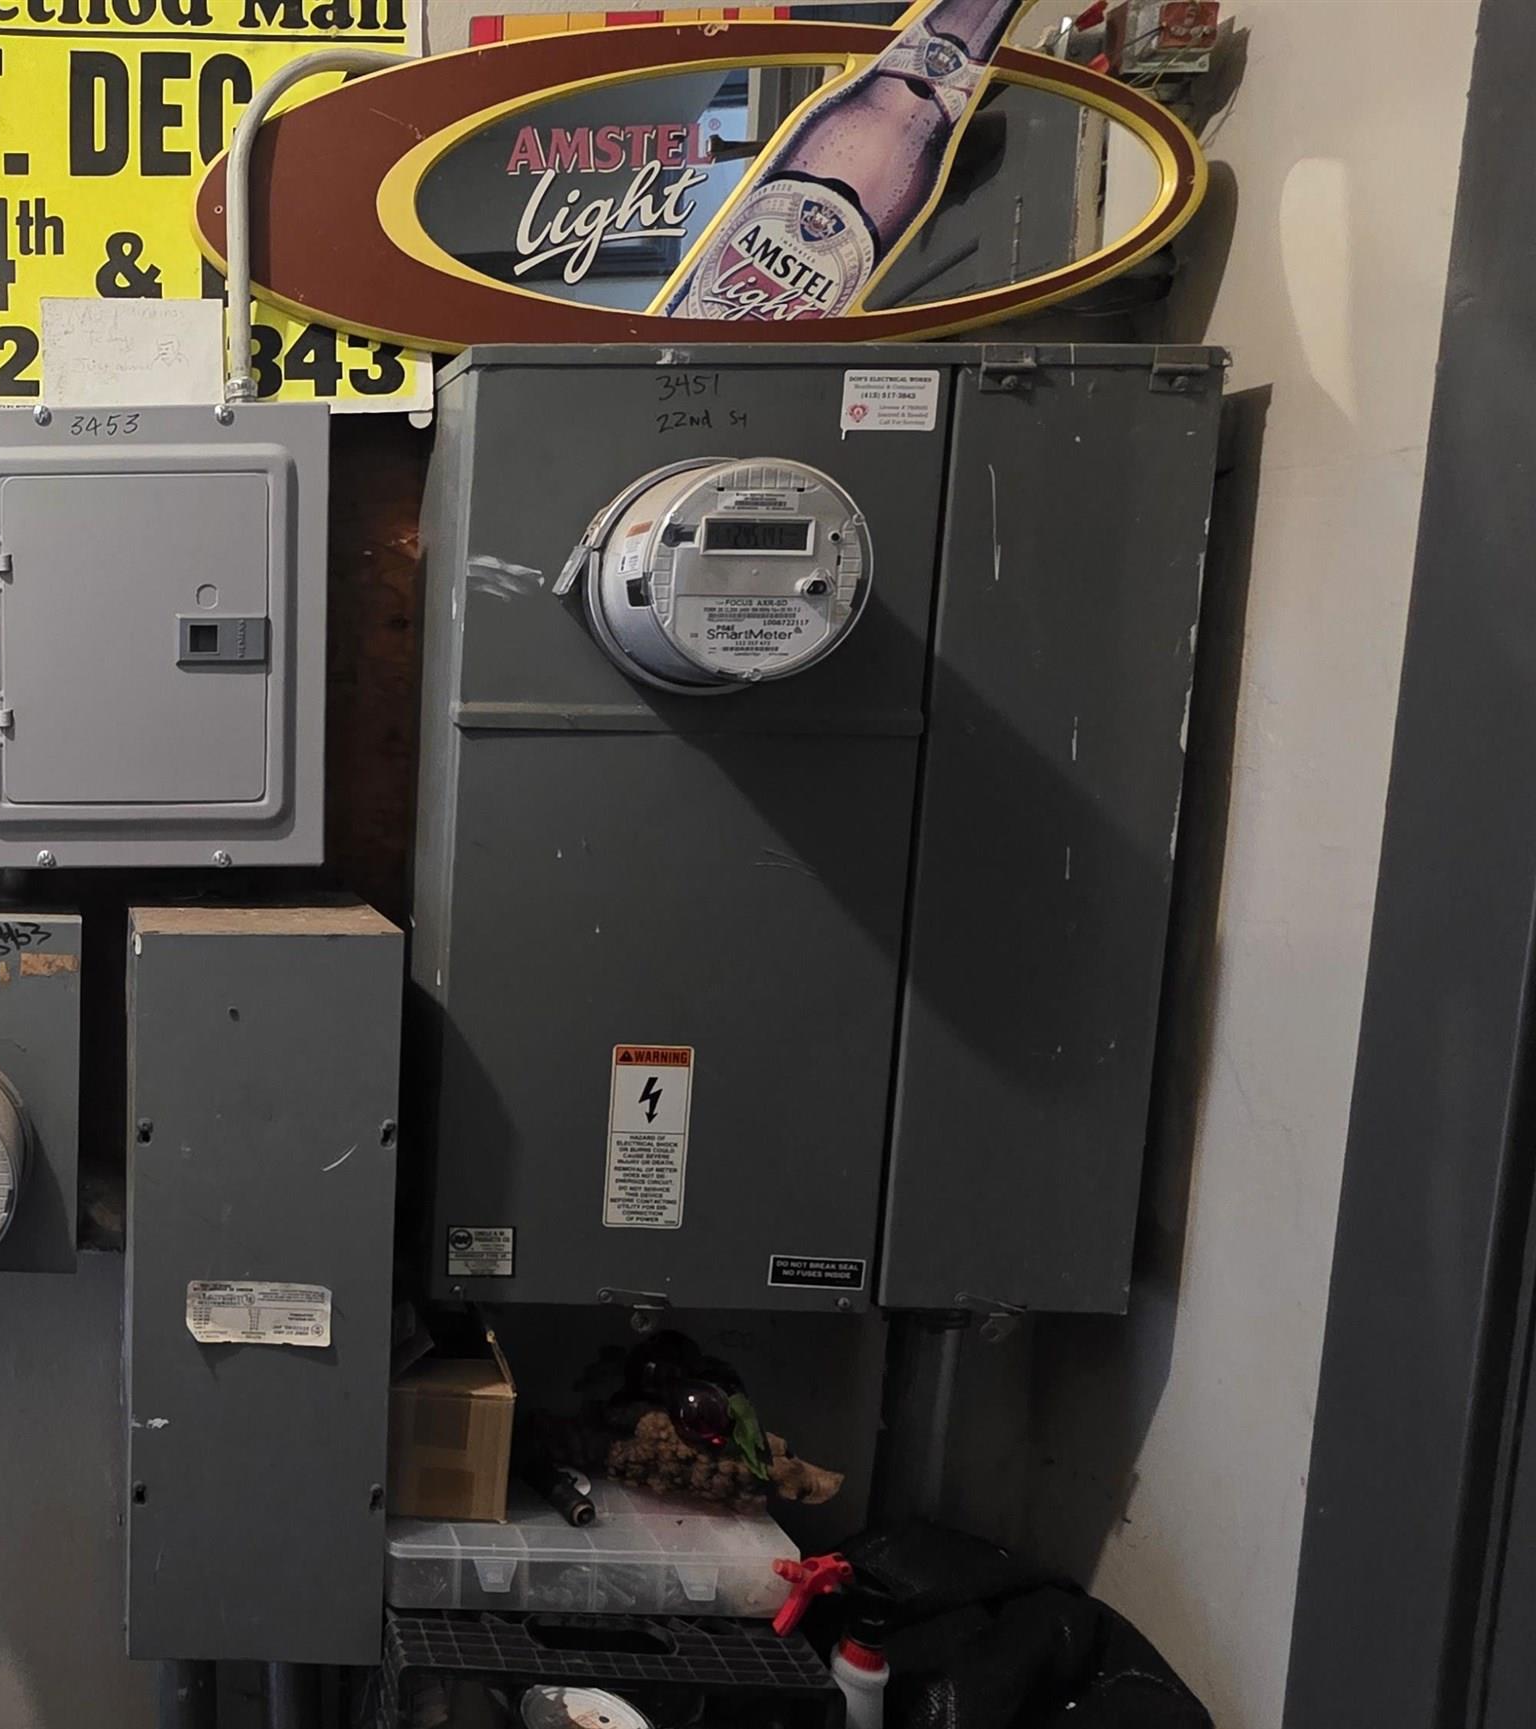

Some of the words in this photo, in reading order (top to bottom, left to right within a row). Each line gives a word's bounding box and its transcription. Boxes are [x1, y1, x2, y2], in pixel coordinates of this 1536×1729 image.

[239, 0, 407, 30] Man
[95, 231, 163, 298] &
[737, 224, 835, 304] AMSTEL
[655, 373, 720, 401] 3451
[70, 413, 141, 437] 3453
[706, 629, 793, 640] SmartMeter
[633, 1051, 689, 1065] WARNING
[790, 1260, 807, 1268] NOT
[809, 1262, 836, 1270] BREAK
[838, 1263, 859, 1271] SEAL
[796, 1270, 823, 1278] FUSES
[824, 1271, 851, 1279] INSIDE
